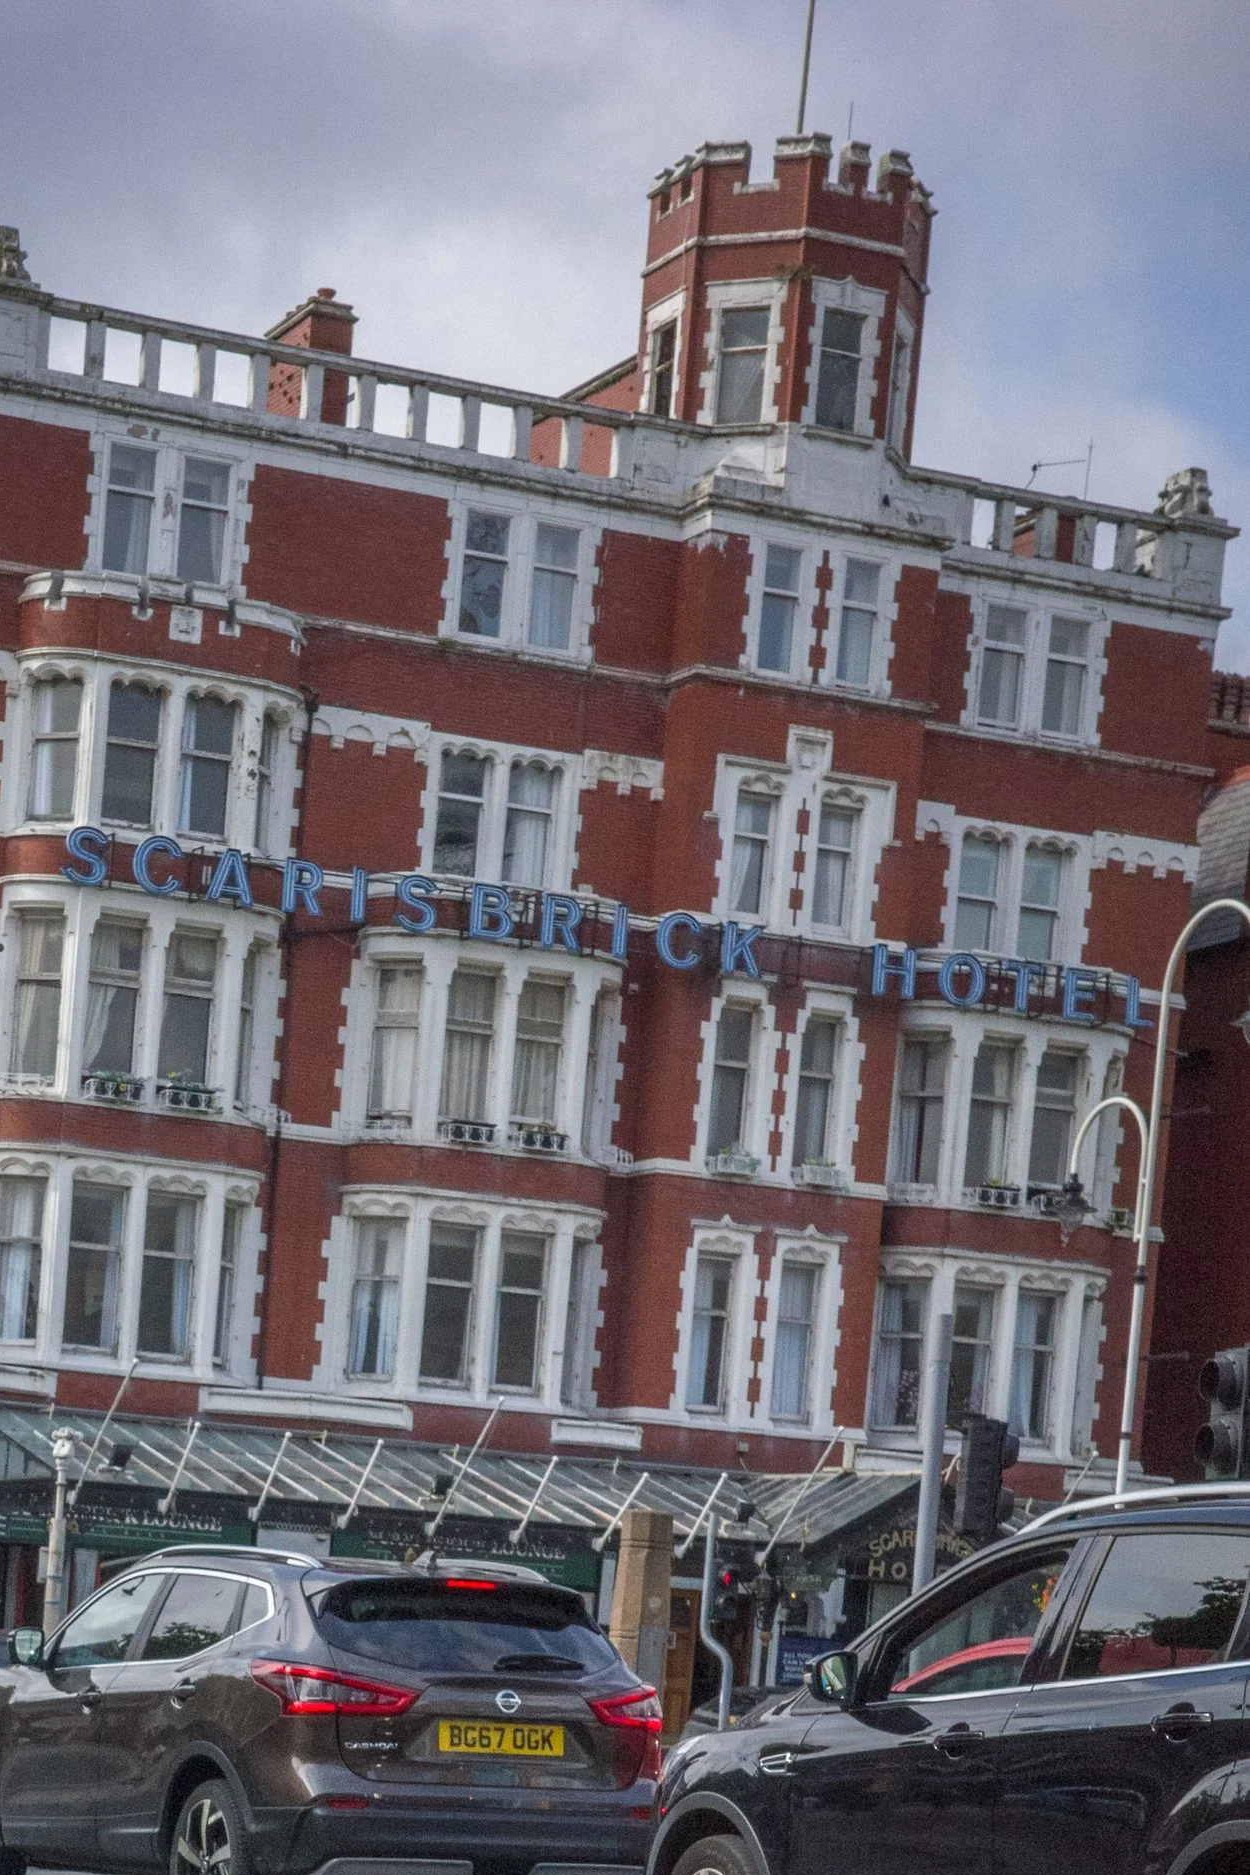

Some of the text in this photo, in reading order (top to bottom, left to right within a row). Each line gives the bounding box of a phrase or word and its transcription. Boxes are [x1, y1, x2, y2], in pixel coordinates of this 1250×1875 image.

[61, 825, 1154, 1030] SCARISBRICK HOTEL
[448, 1725, 554, 1752] BG67 OGK
